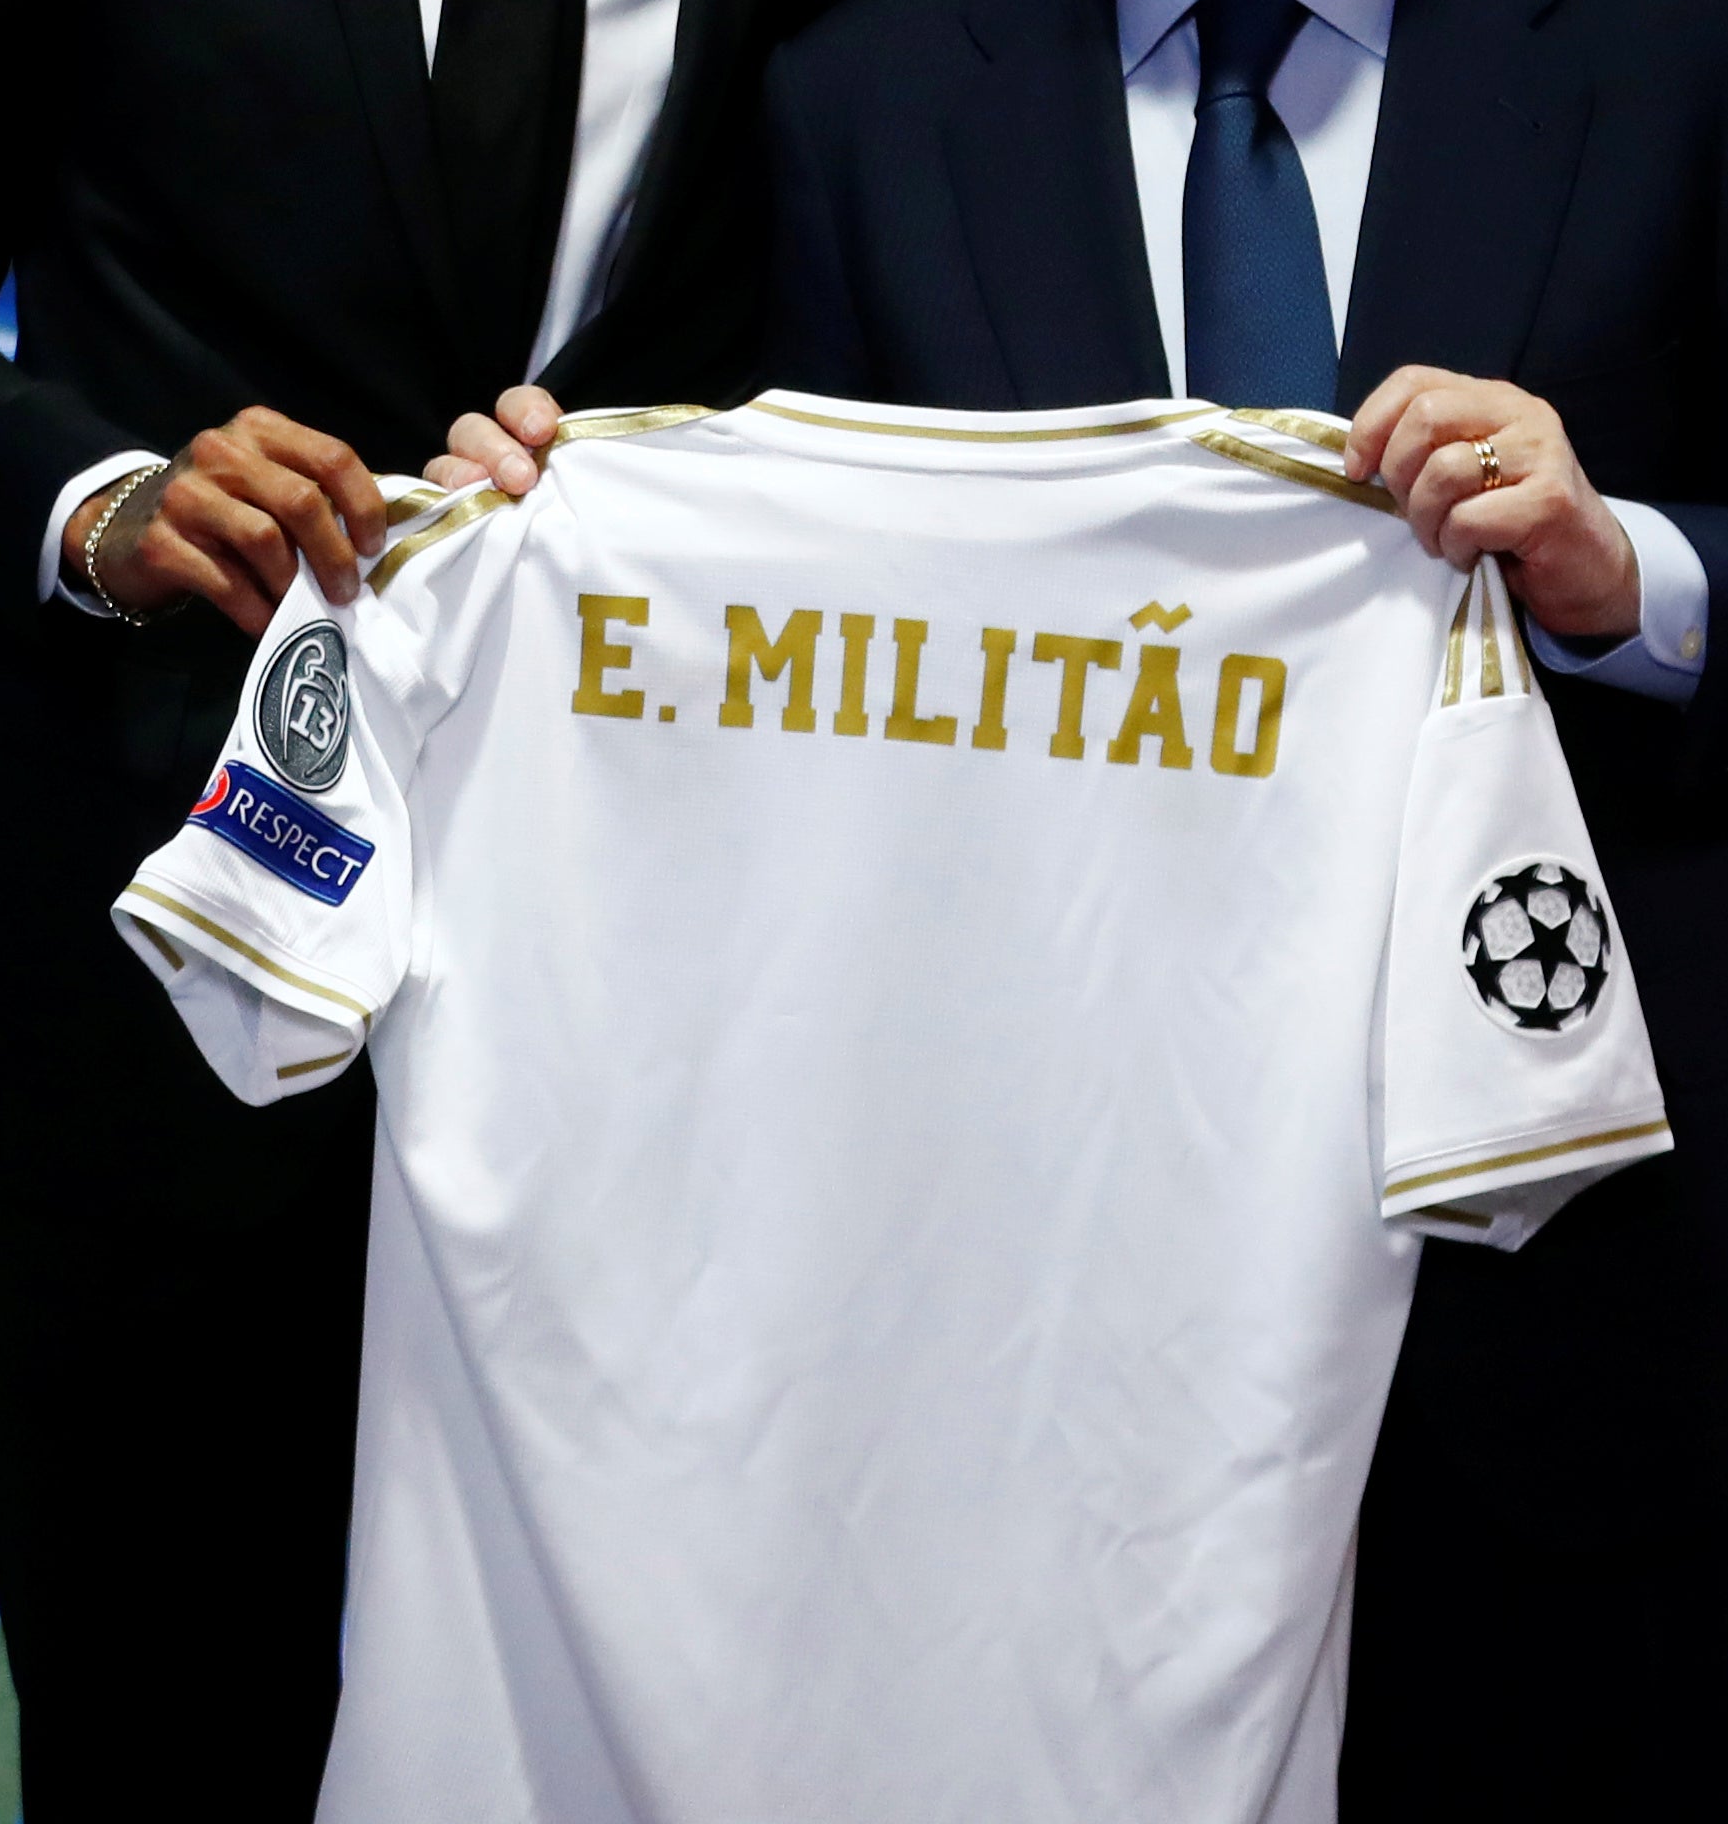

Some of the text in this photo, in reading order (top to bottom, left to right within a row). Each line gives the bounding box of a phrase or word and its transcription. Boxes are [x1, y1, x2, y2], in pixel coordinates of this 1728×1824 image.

[288, 694, 339, 752] 13
[571, 593, 1288, 780] E. MILITÃO
[226, 787, 363, 887] RESPECT
